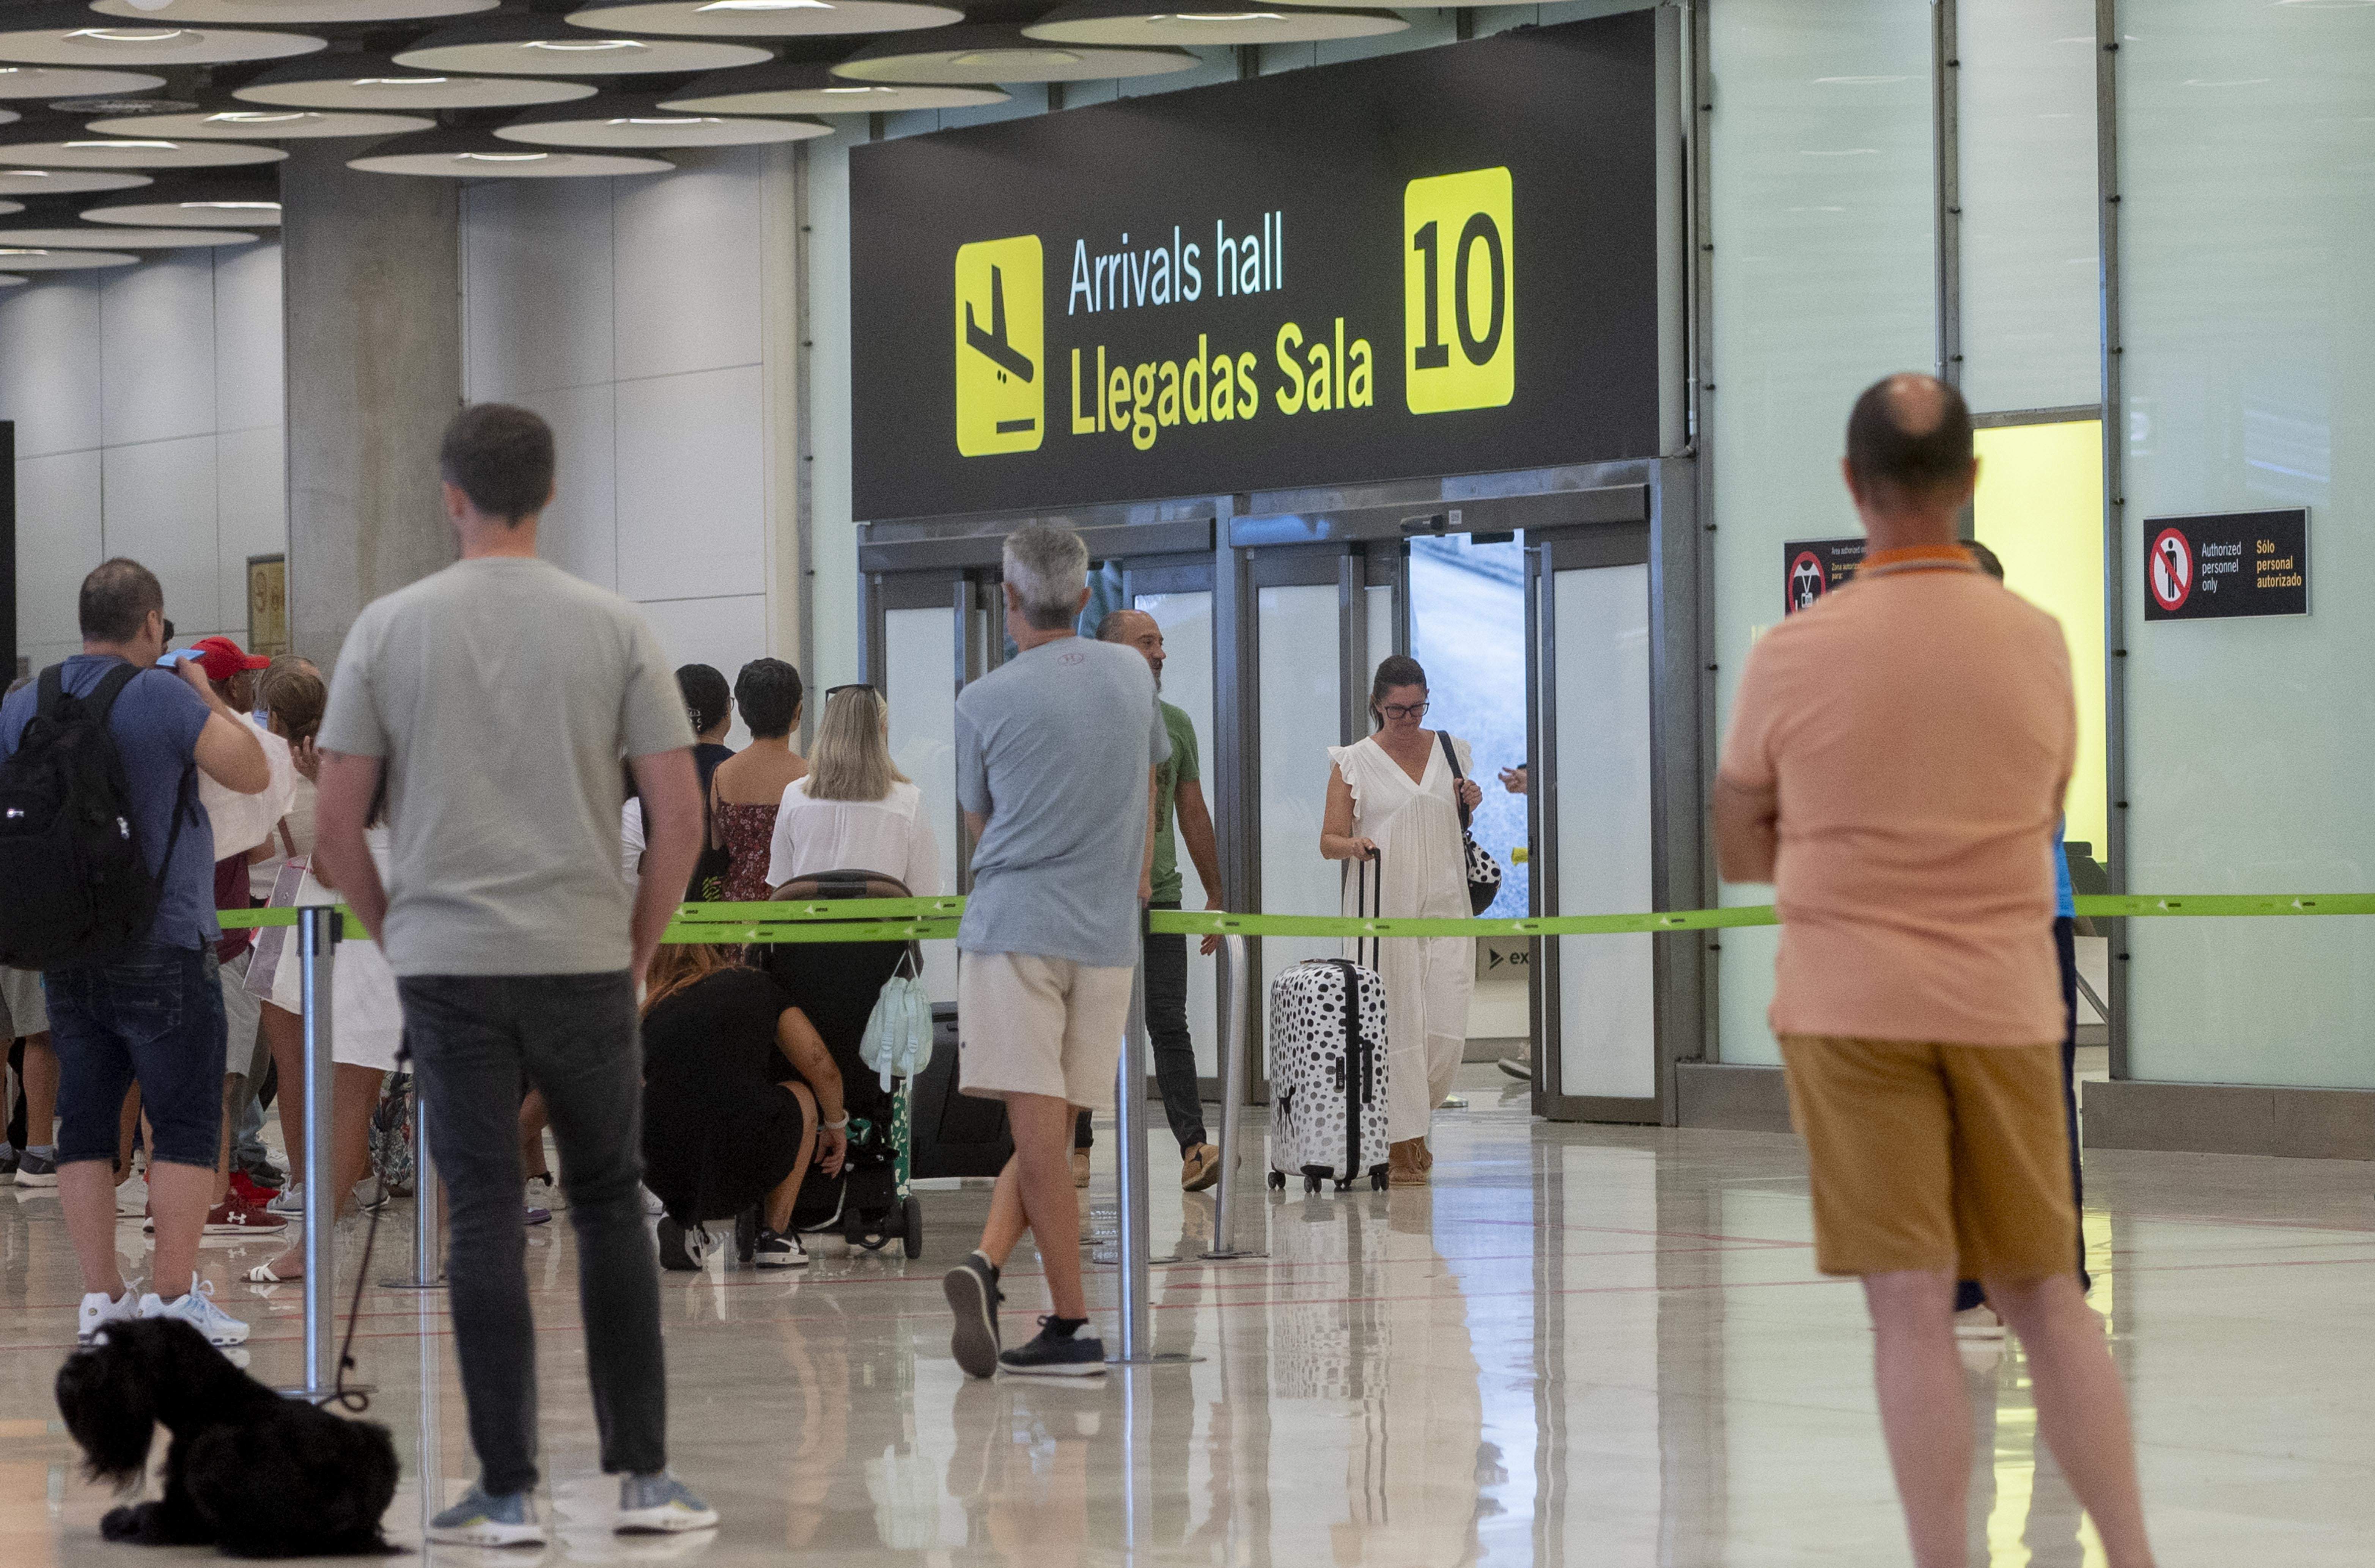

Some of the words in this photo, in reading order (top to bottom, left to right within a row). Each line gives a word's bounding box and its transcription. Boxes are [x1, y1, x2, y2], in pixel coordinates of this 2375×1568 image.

[1068, 225, 1202, 316] Arrivals
[1216, 210, 1282, 297] hall
[1414, 211, 1505, 370] 10
[1071, 333, 1259, 451] Llegadas
[1275, 317, 1373, 415] Sala
[2202, 541, 2241, 557] Authorized
[2256, 539, 2275, 554] Sólo
[2202, 559, 2239, 576] personnel
[2257, 556, 2293, 573] personal
[2202, 577, 2218, 593] only
[2257, 572, 2302, 588] autorizado
